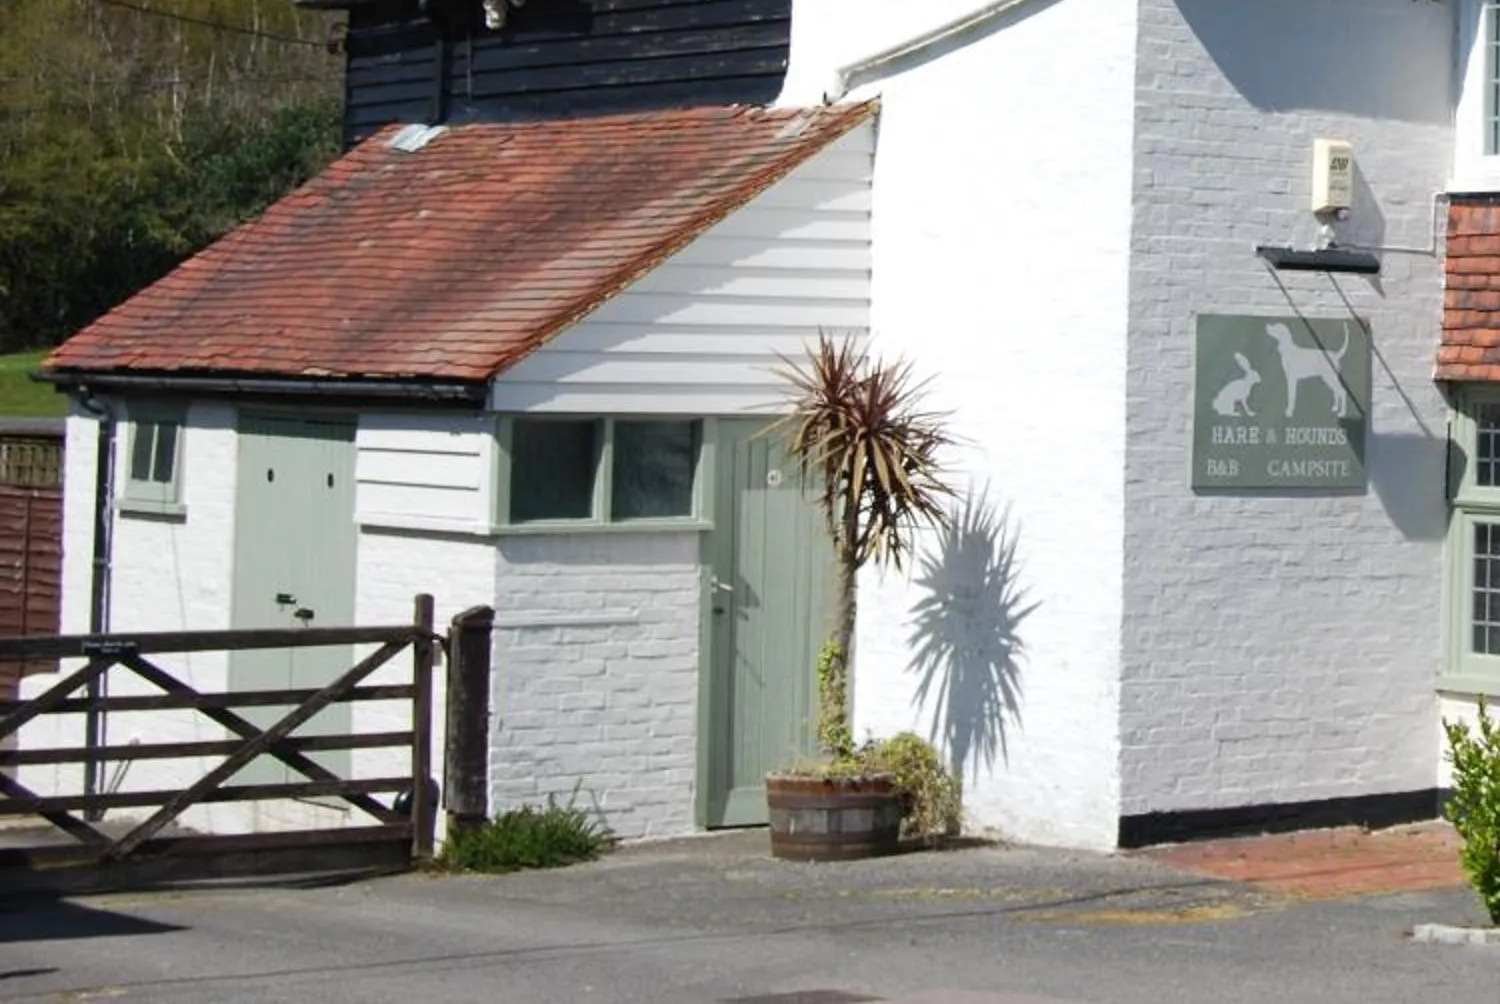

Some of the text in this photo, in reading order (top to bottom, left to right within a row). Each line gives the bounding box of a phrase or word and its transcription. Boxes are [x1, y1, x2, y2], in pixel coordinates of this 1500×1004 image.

[1212, 425, 1260, 444] HARE
[1284, 427, 1348, 445] HOUNDS
[1206, 458, 1350, 477] B&B CAMPSITE
